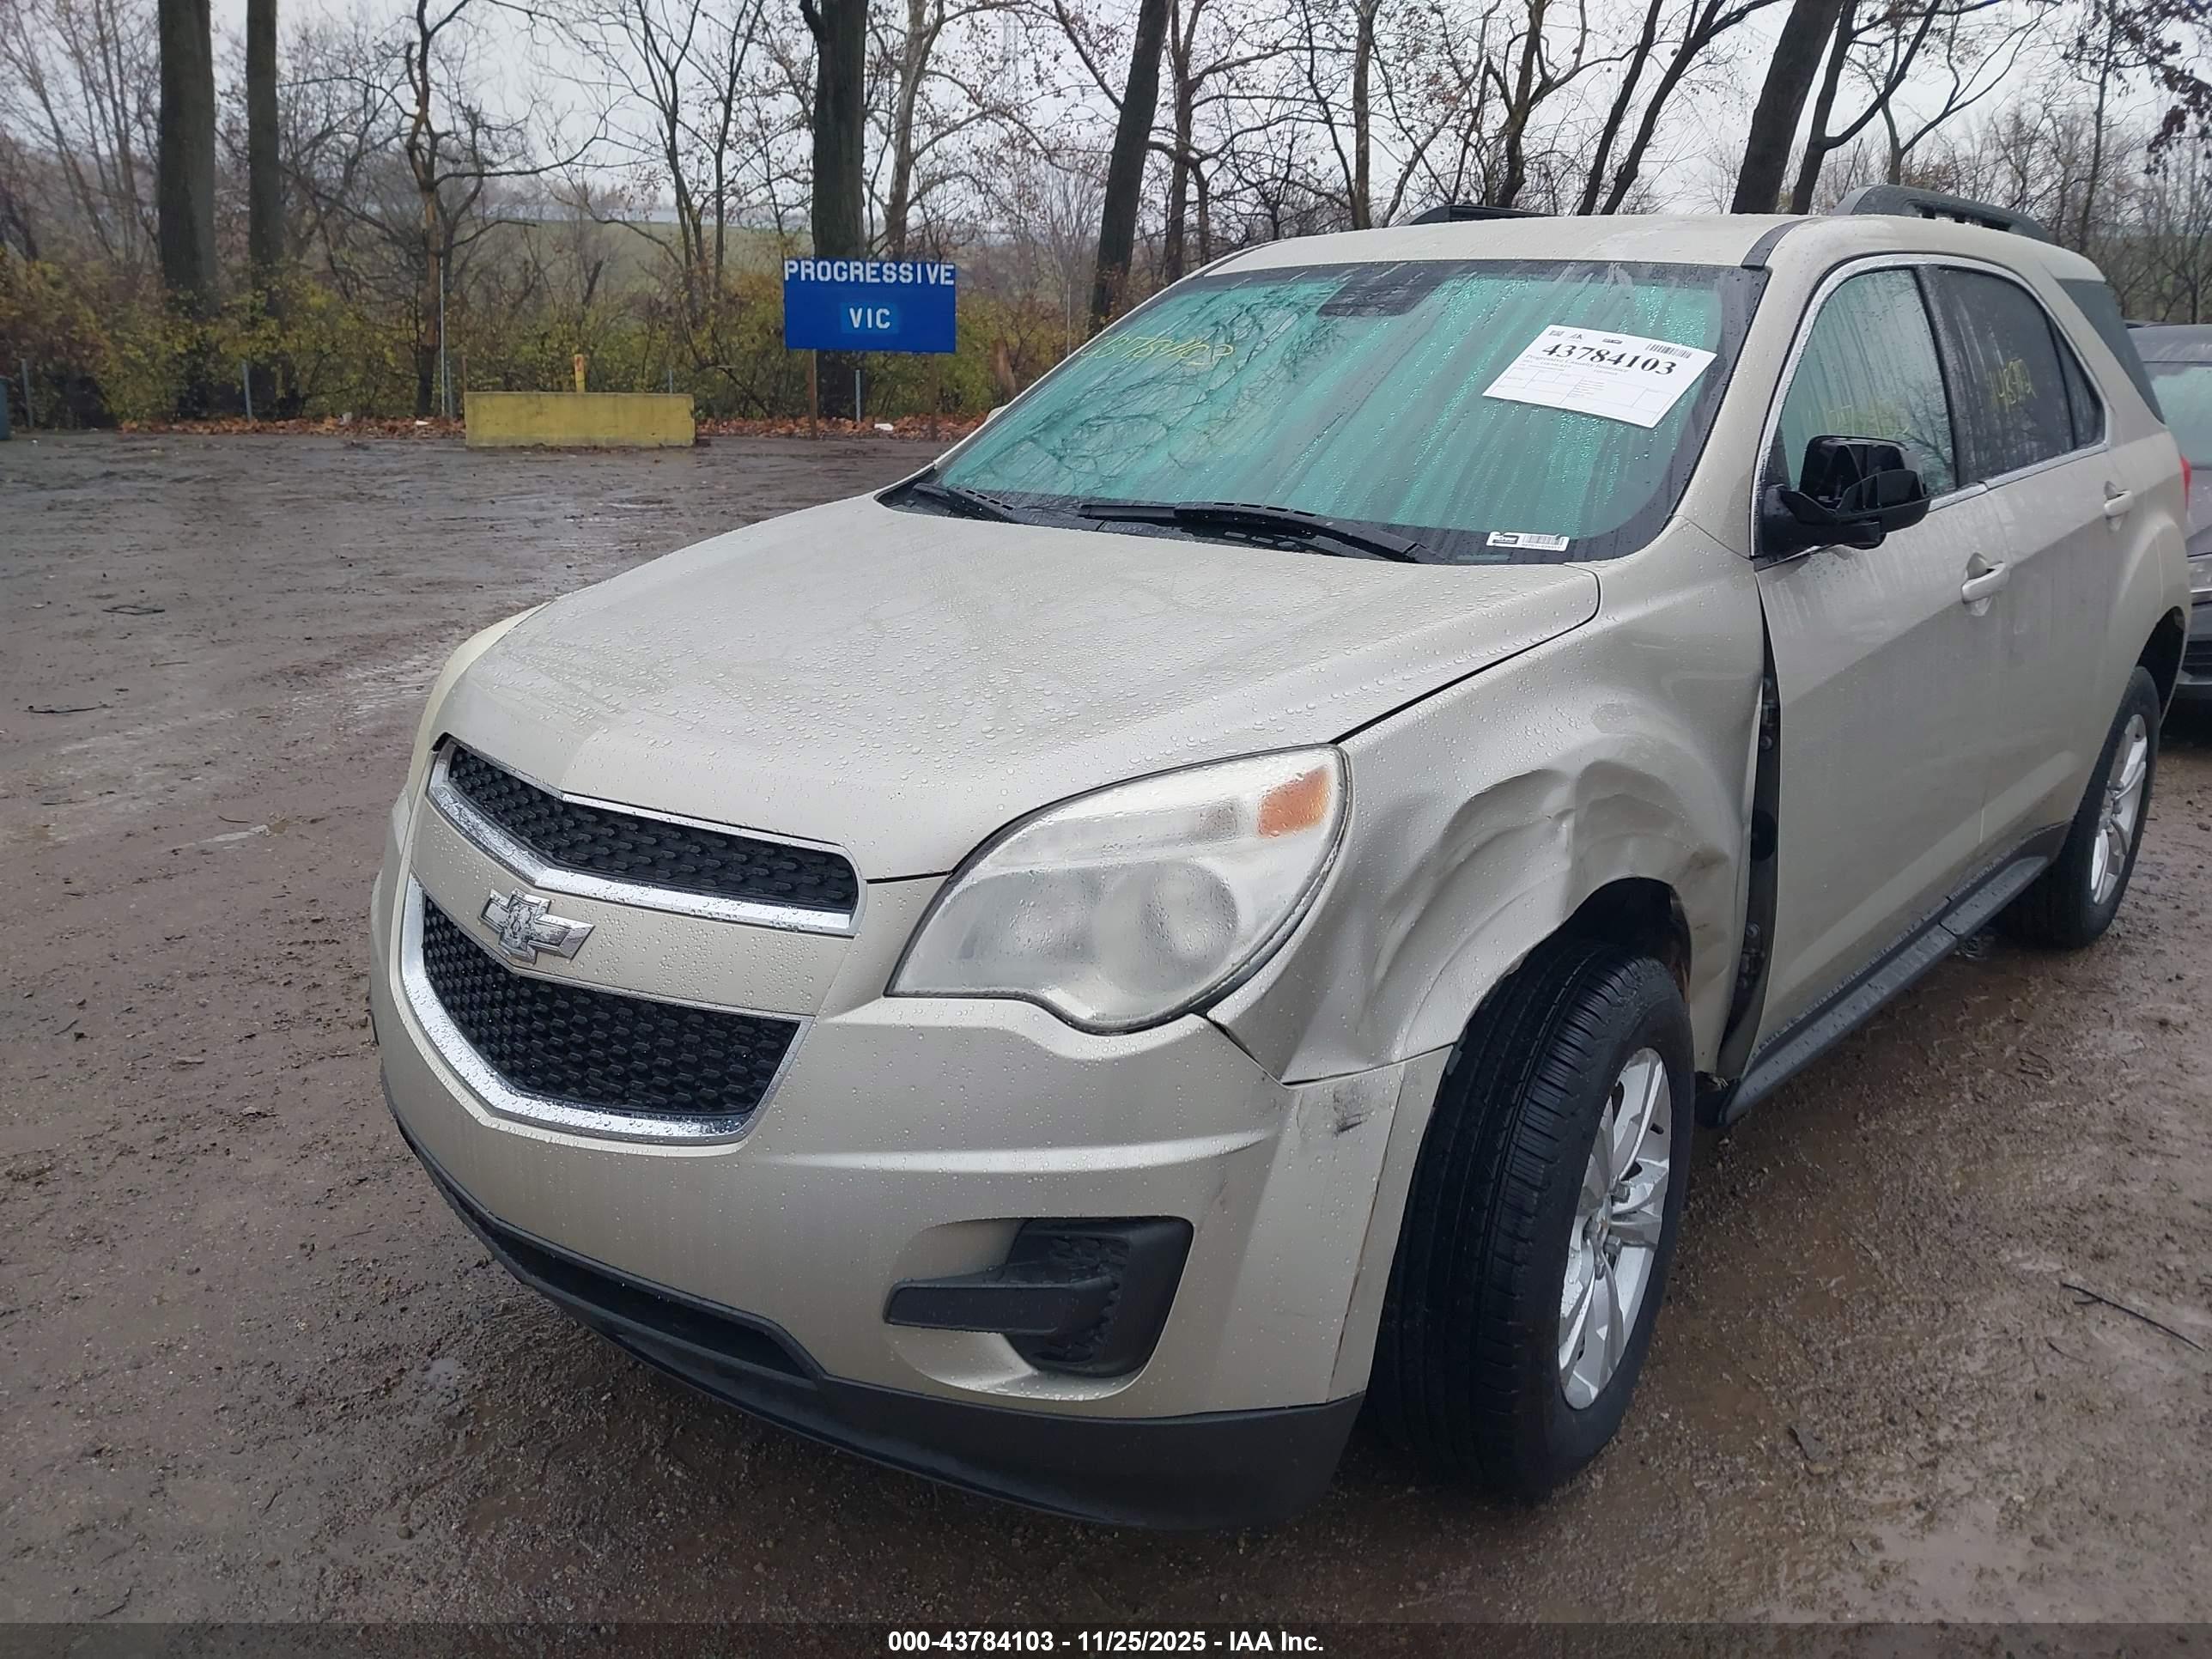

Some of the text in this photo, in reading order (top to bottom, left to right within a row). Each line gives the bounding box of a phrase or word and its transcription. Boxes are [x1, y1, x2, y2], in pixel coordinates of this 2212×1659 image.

[784, 259, 955, 286] PROGRESSIVE
[848, 307, 891, 330] VIC
[1541, 343, 1677, 375] 43784103
